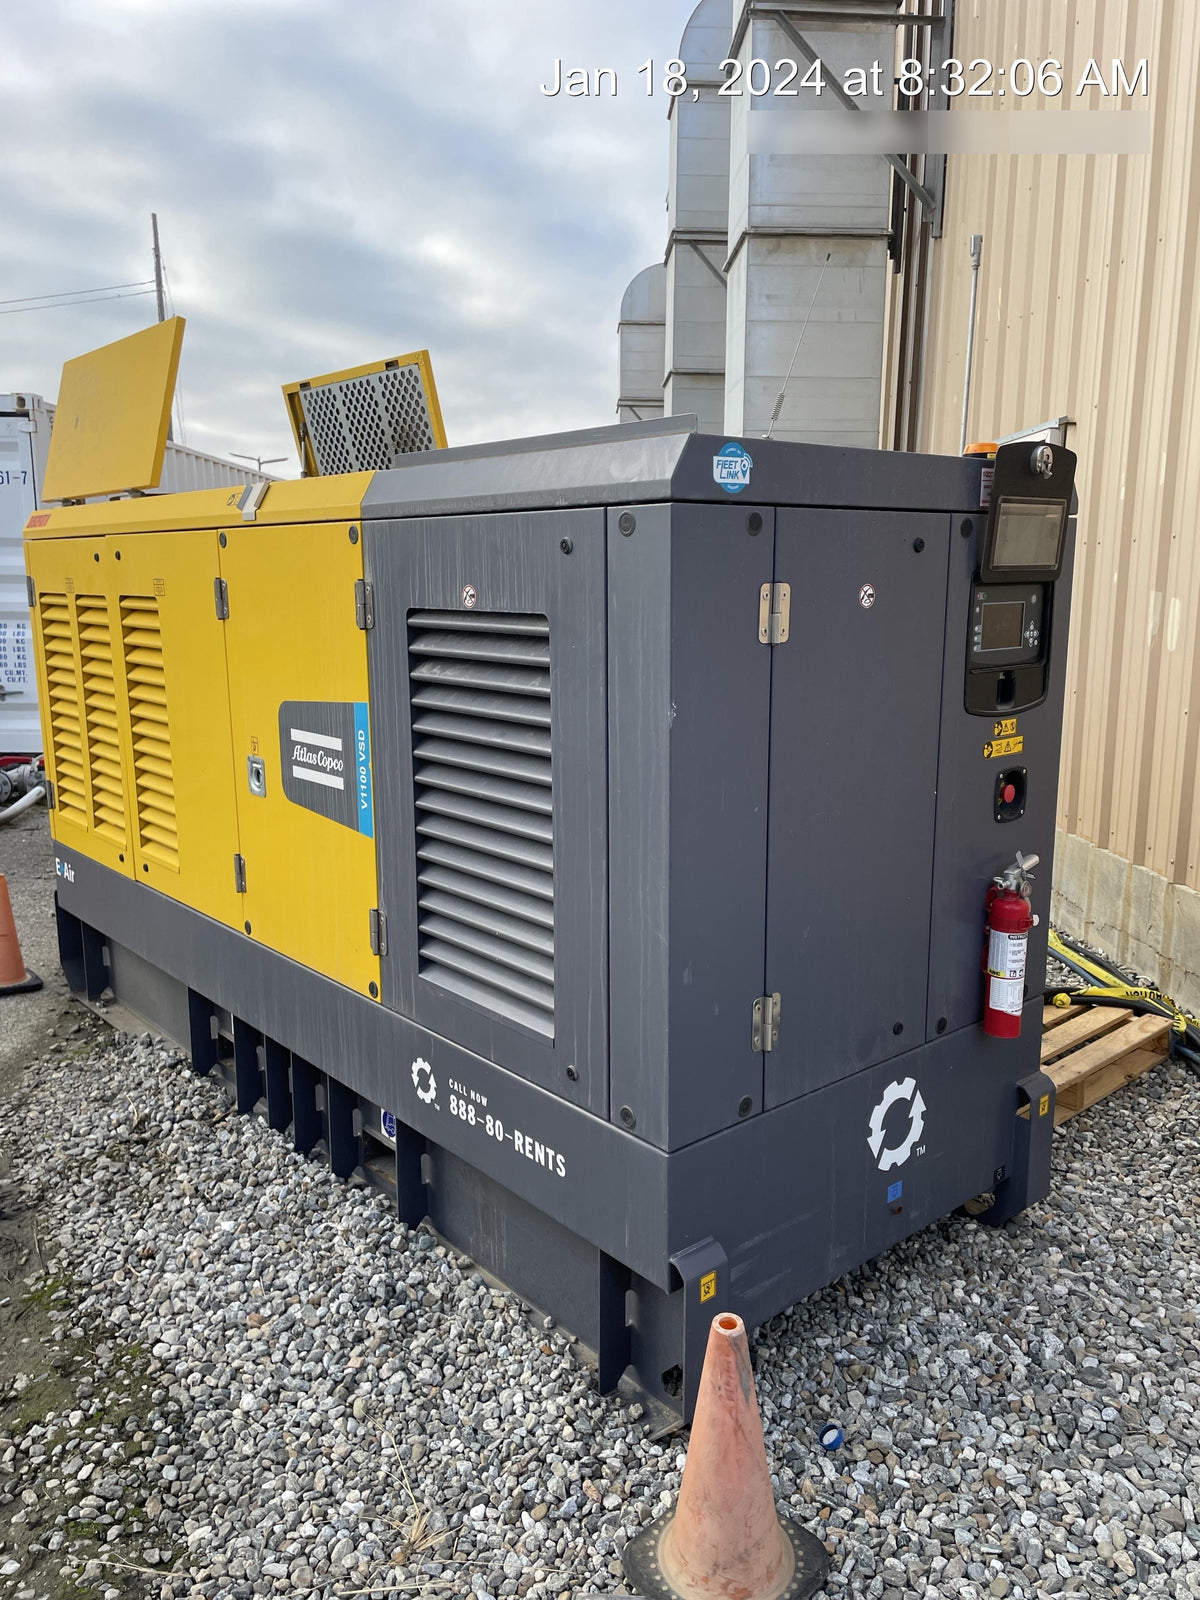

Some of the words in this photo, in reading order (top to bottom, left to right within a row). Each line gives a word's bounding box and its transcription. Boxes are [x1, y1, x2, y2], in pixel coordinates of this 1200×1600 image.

[720, 470, 740, 480] LINK
[291, 744, 317, 766] Atlas
[317, 750, 344, 772] Copco
[358, 730, 366, 762] VSD
[359, 766, 368, 810] V1100
[448, 1078, 468, 1097] CALL
[470, 1089, 488, 1108] NOW
[449, 1094, 567, 1178] 888-80-RENTS
[916, 1145, 926, 1157] TM
